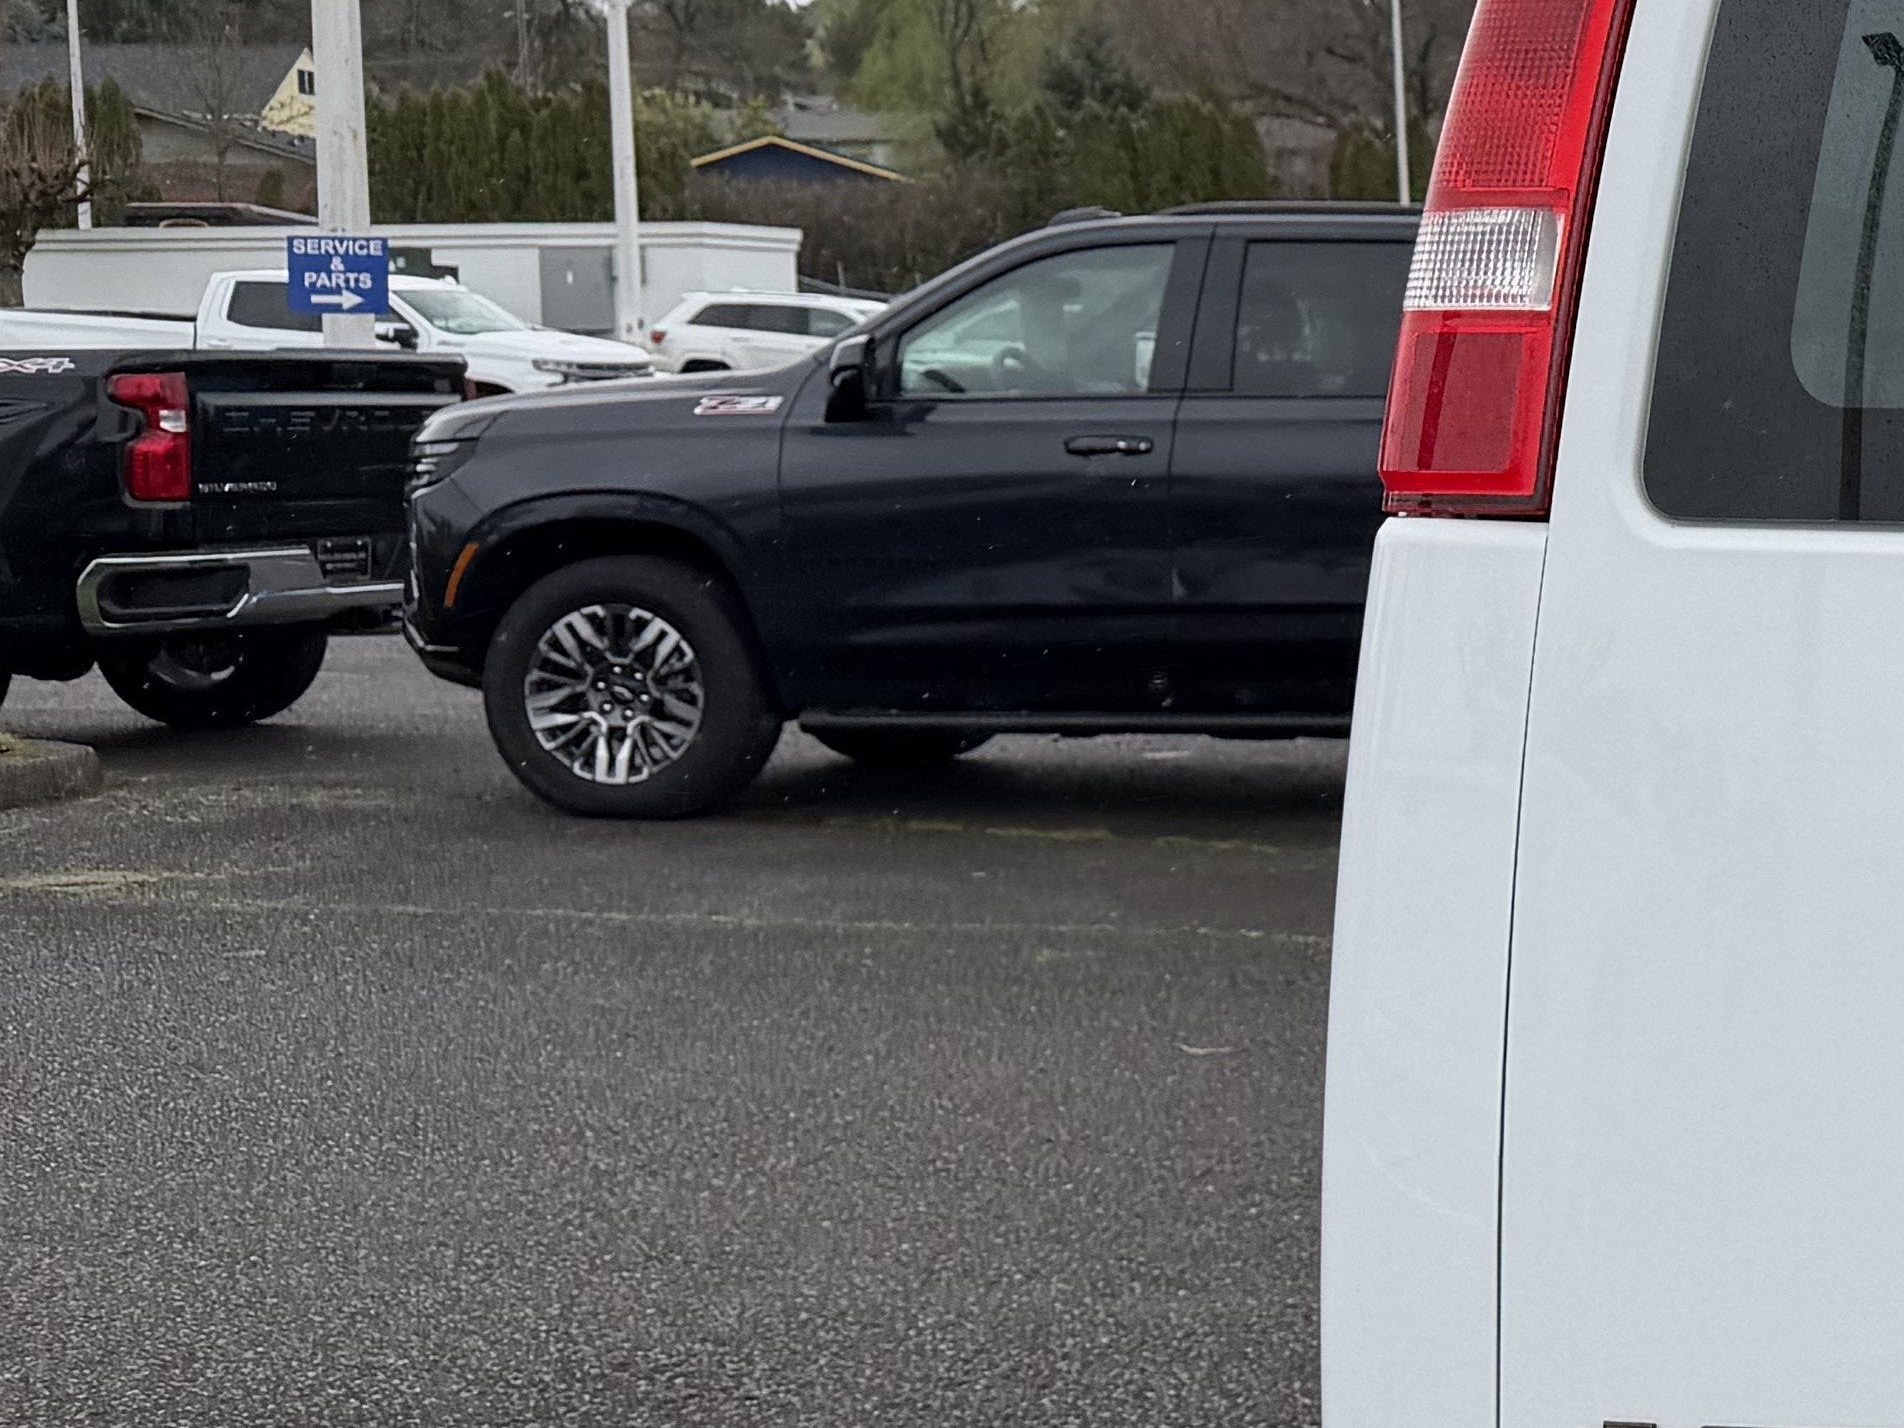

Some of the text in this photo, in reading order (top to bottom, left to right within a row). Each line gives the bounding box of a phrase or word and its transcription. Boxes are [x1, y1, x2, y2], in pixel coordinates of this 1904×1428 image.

[292, 238, 384, 257] SERVICE
[330, 255, 345, 271] &
[303, 271, 373, 290] PARTS
